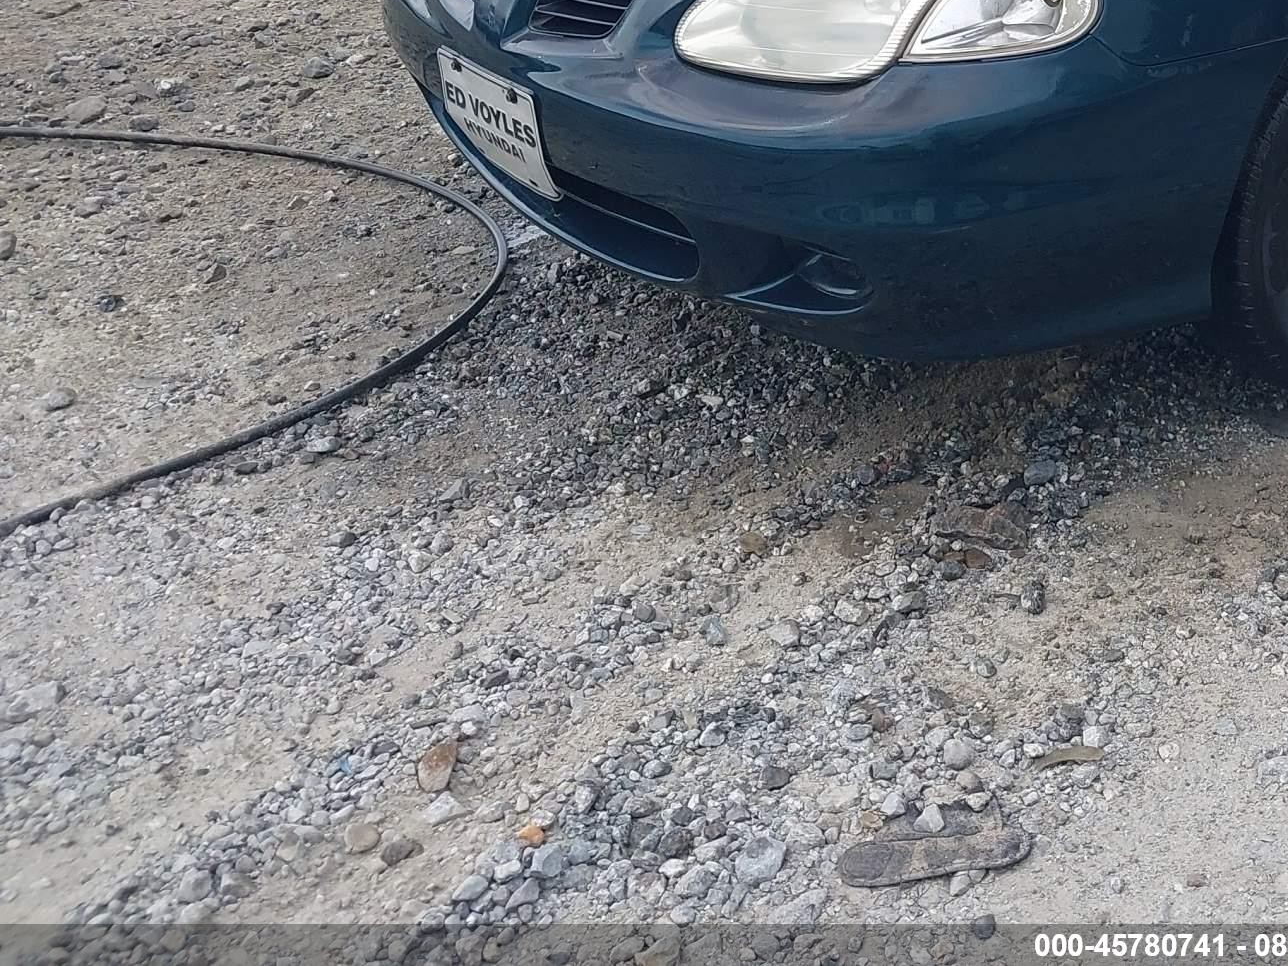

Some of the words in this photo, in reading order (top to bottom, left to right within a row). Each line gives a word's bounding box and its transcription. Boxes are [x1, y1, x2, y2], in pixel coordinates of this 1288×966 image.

[444, 81, 467, 110] ED
[469, 93, 537, 148] VOYLES
[463, 117, 527, 163] HYUNDAI
